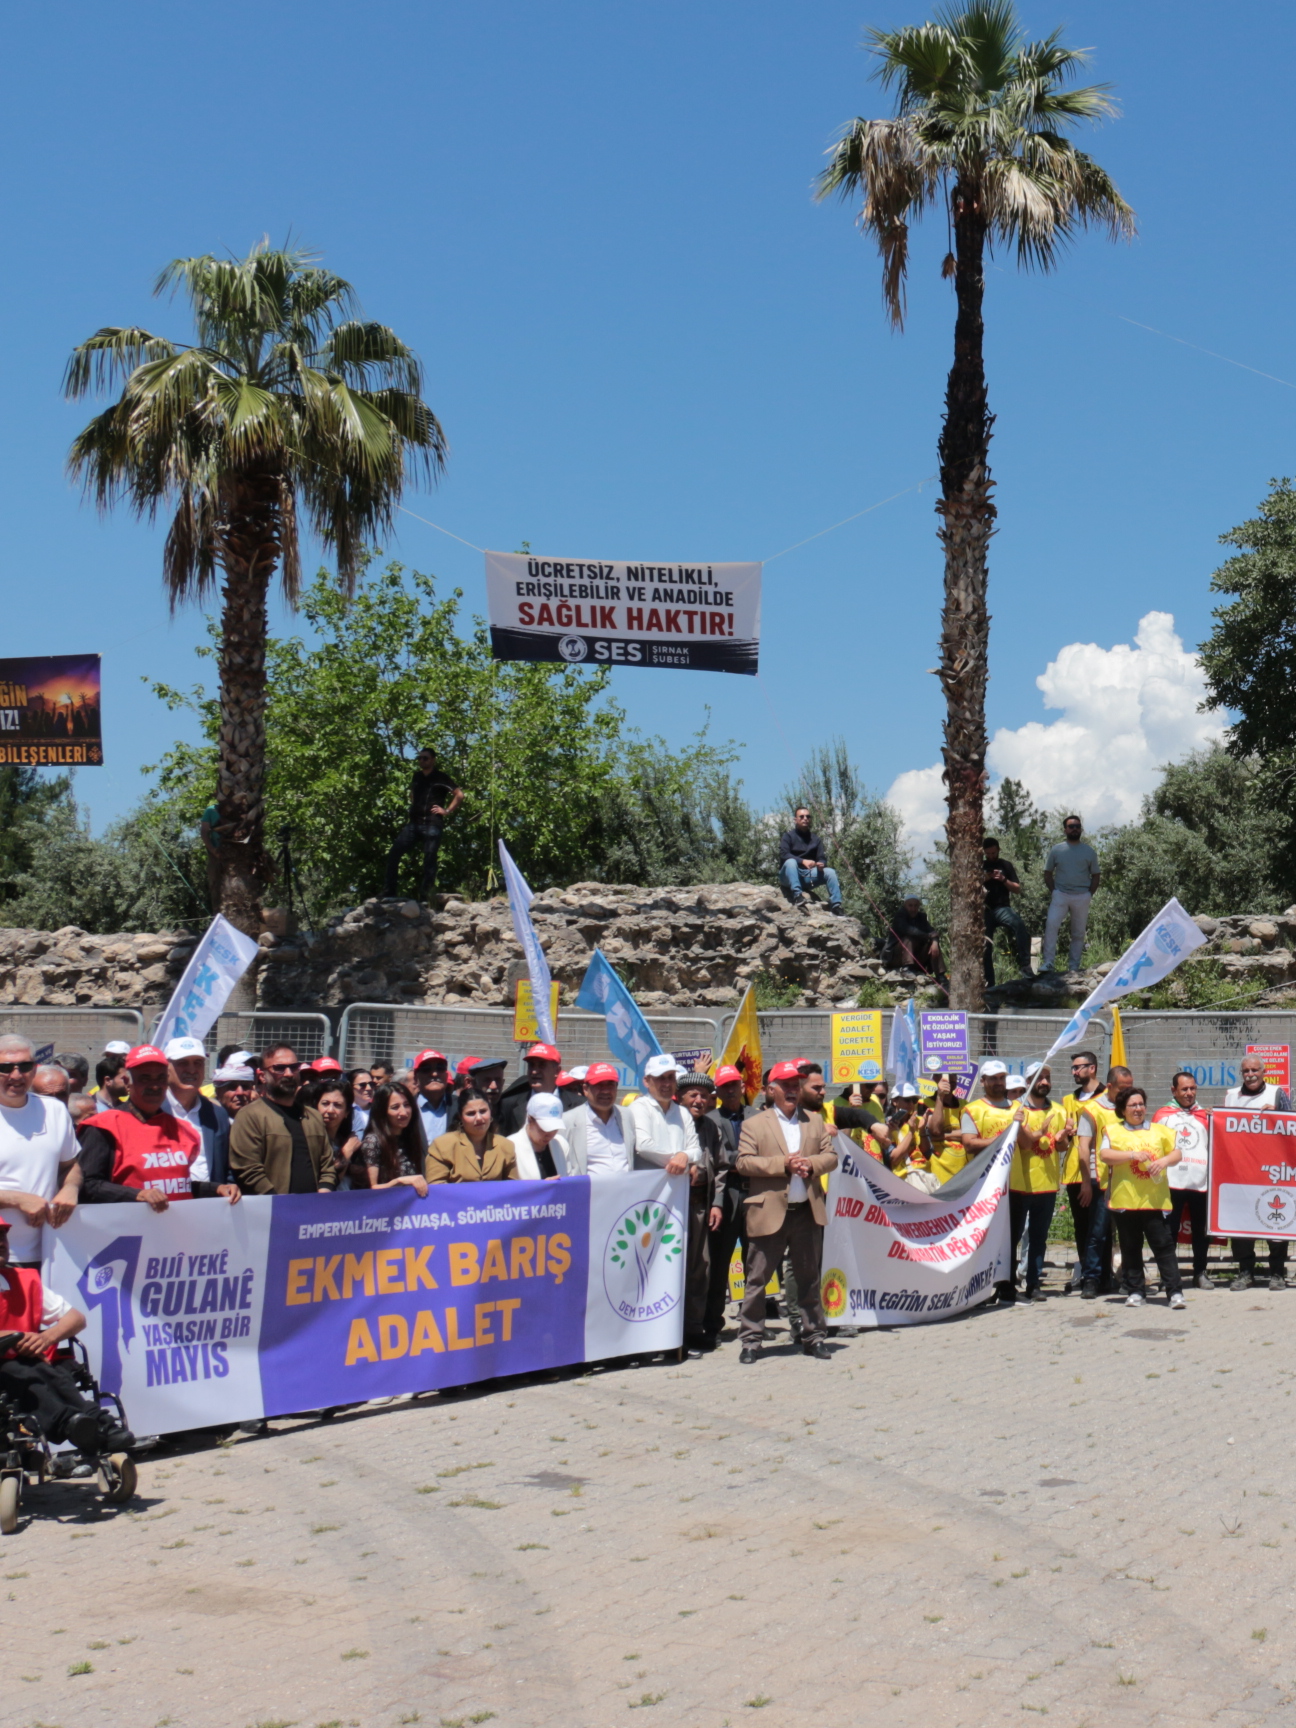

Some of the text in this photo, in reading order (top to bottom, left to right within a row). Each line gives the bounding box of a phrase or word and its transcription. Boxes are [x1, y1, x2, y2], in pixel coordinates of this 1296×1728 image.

[527, 558, 718, 588] ÜCRETSİZ, NİTELİKLİ,
[516, 578, 734, 607] ERİŞİLEBİLİR VE ANADİLDE
[518, 599, 734, 636] SAĞLIK HAKTIR!
[594, 641, 642, 662] SES
[652, 645, 689, 656] ŞIRNAK
[652, 654, 689, 664] ŞUBESİ
[0, 744, 87, 766] BİLEŞENLERİ
[1155, 924, 1182, 957] KESK
[840, 1014, 873, 1022] VERGİDE
[840, 1025, 874, 1033] ADALET,
[927, 1014, 960, 1022] EKOLOJİK
[932, 1022, 954, 1030] ÖZGÜR
[954, 1022, 965, 1030] BİR
[839, 1036, 874, 1045] ÜCRETTE
[932, 1032, 956, 1040] YAŞAM
[840, 1048, 874, 1056] ADALET!
[857, 1068, 881, 1076] KESK
[834, 1197, 864, 1218] AZAD
[298, 1203, 566, 1240] EMPERYALİZME, SAVAŞA, SÖMÜRÜYE KARŞI
[145, 1249, 229, 1280] BIJÎ YEKÊ
[285, 1232, 572, 1306] EKMEK BARIŞ
[140, 1268, 254, 1318] GULANÊ
[618, 1291, 675, 1318] DEM PARTİ
[850, 1285, 959, 1317] ŞAXA EGÎTÎM SENÊ
[142, 1312, 252, 1350] YAŞASIN BİR
[344, 1298, 521, 1366] ADALET
[145, 1341, 230, 1388] MAYIS
